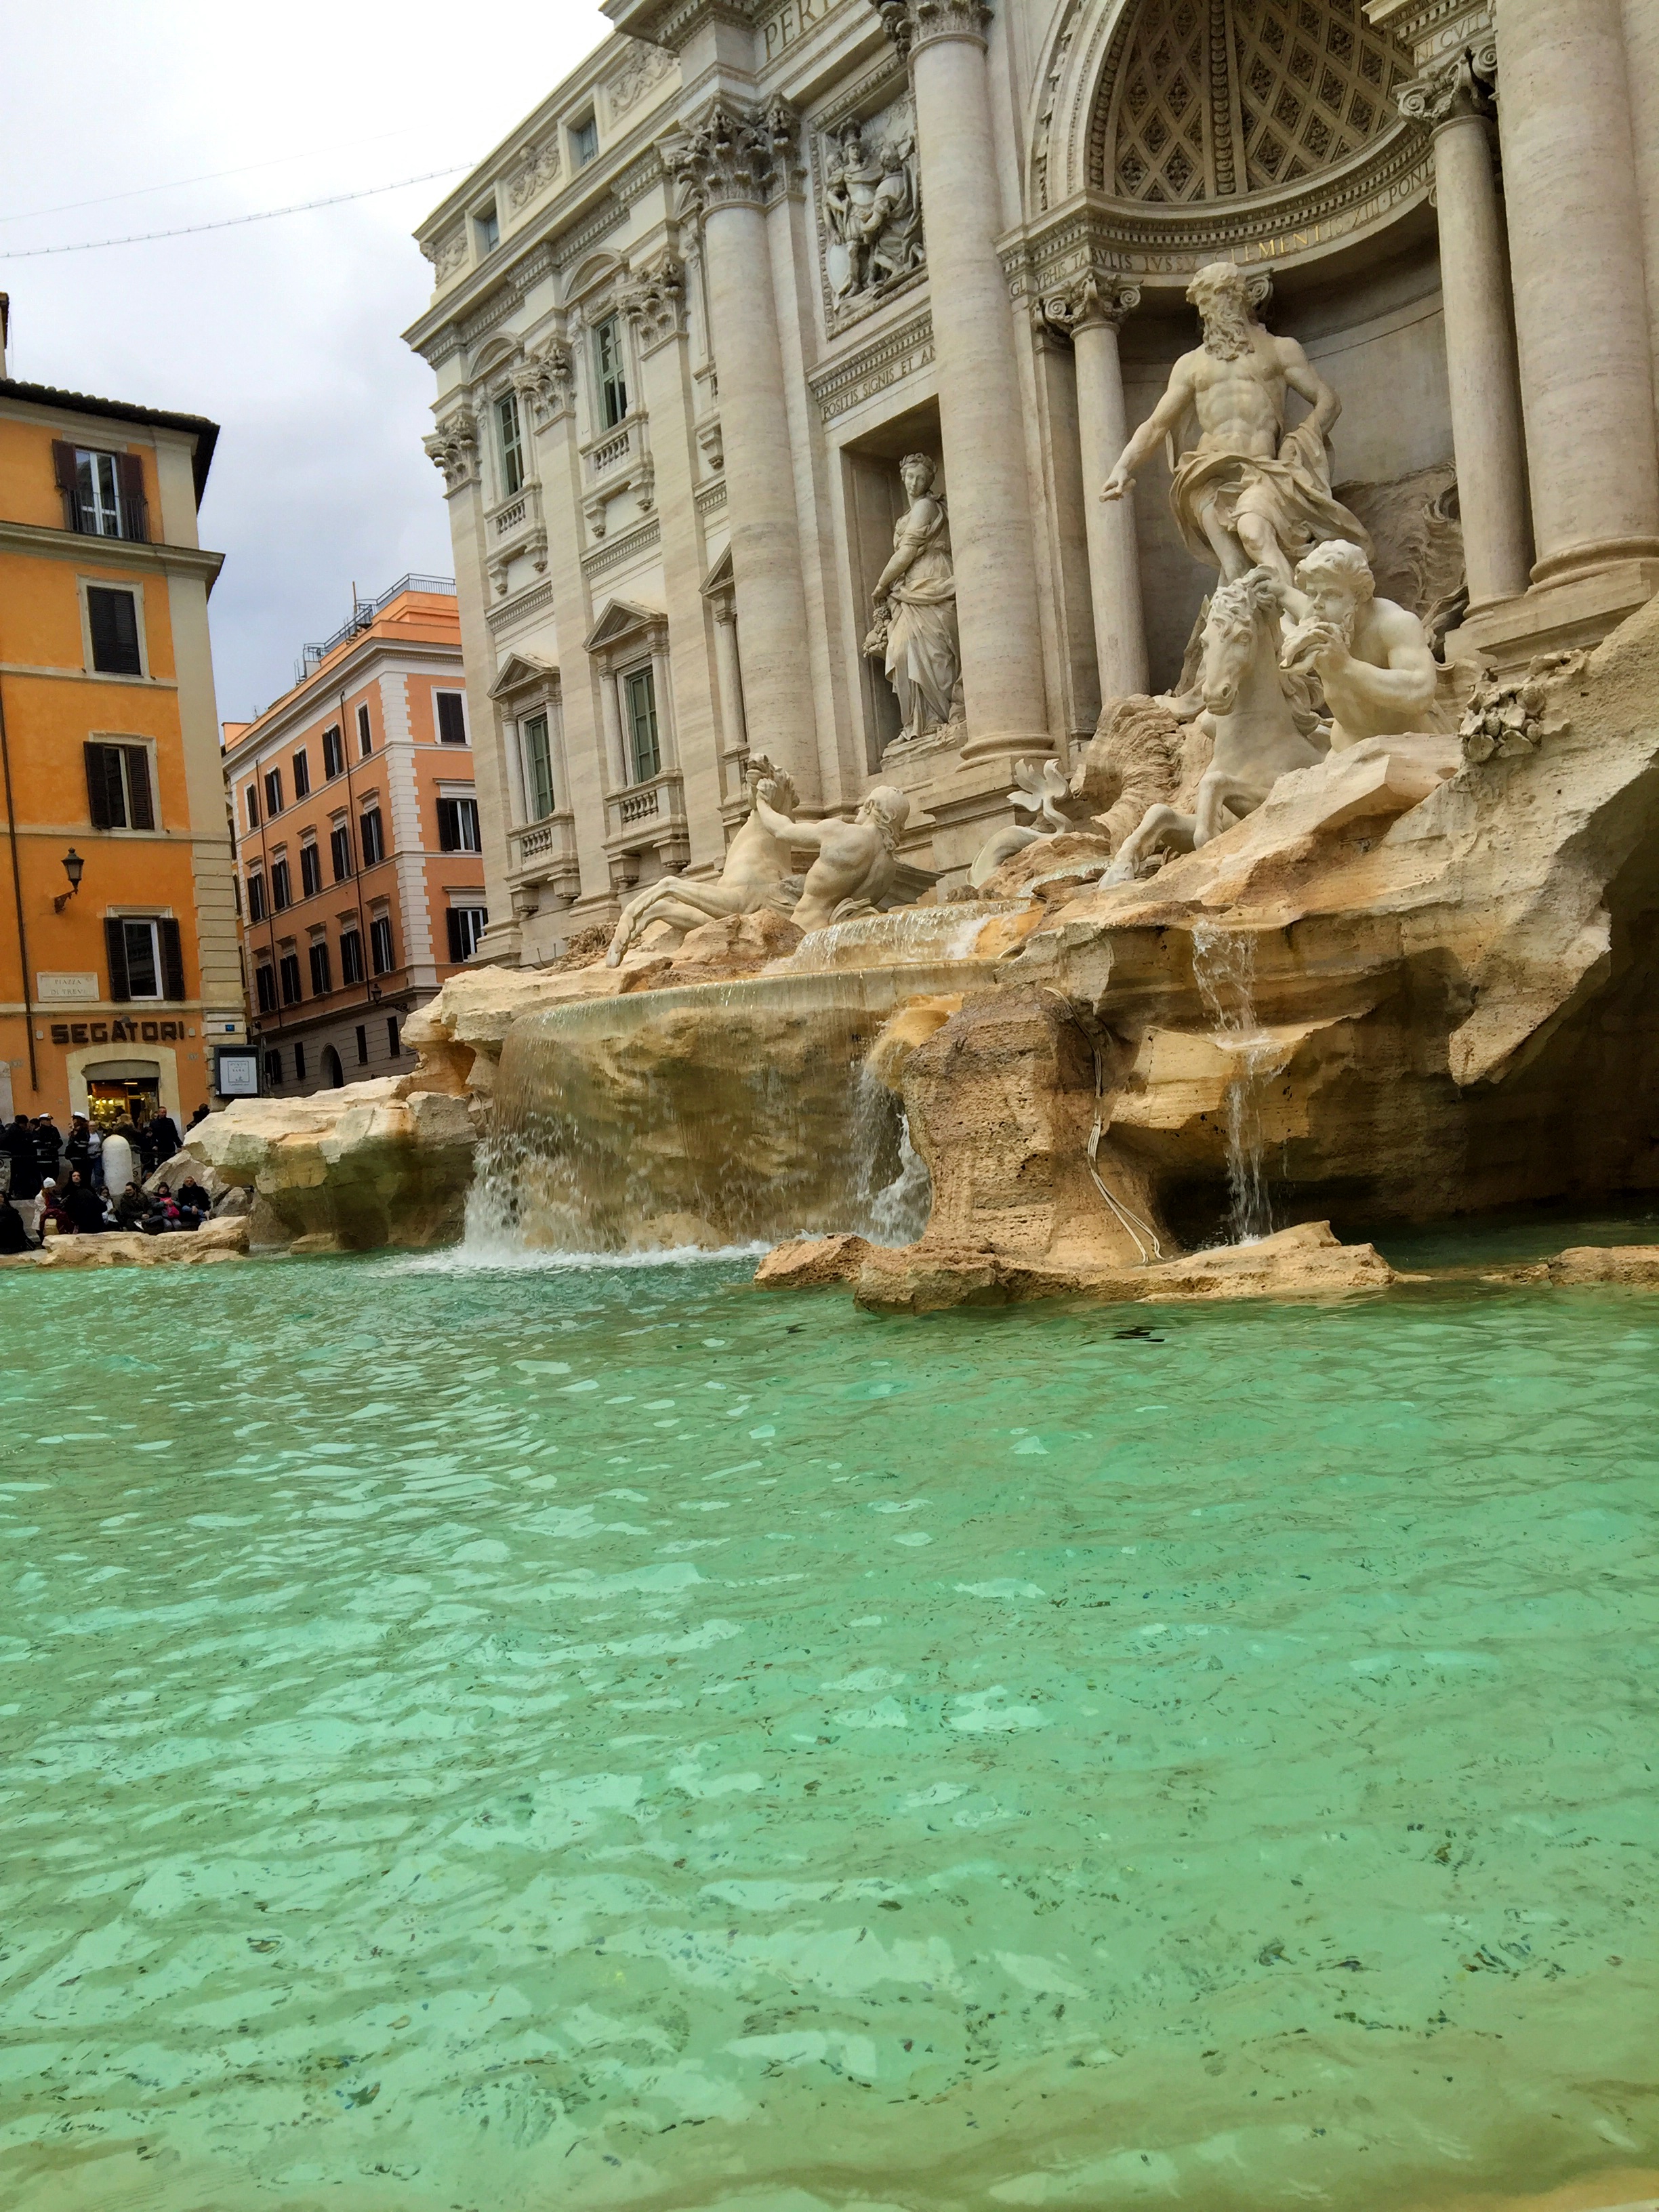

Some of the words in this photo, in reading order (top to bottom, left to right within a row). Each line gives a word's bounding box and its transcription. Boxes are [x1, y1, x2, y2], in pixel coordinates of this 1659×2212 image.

[823, 388, 859, 419] POSITIS
[863, 367, 895, 397] SIGNIS
[901, 356, 914, 375] ET
[51, 1019, 184, 1044] SEGATORI
